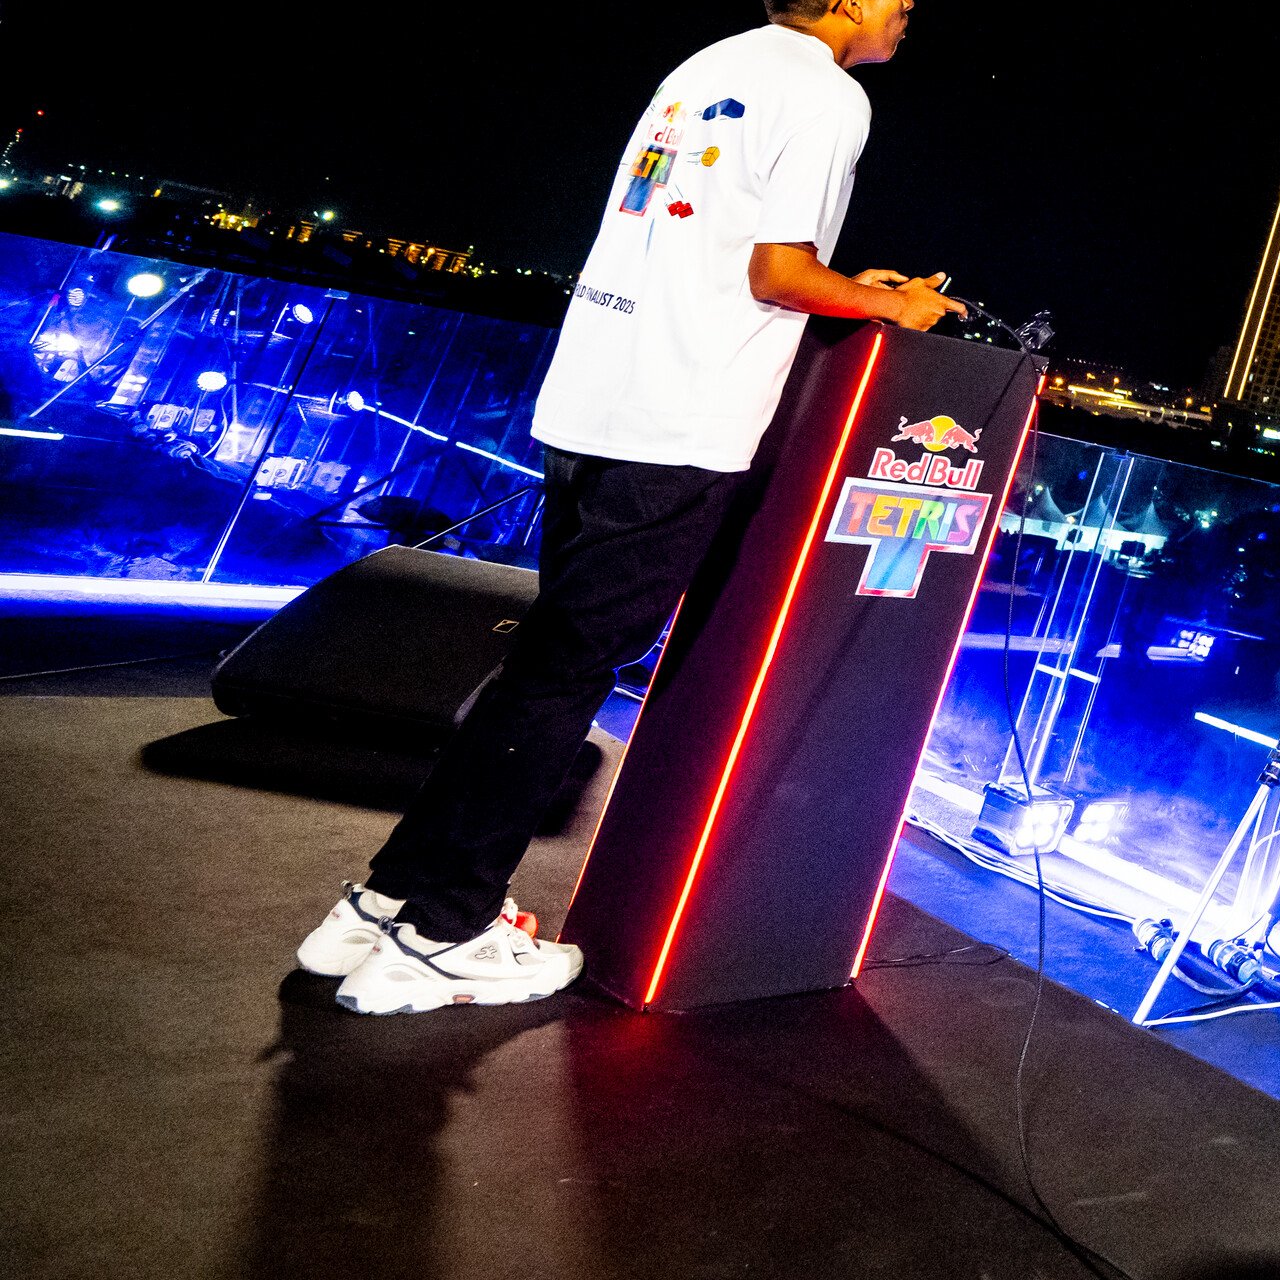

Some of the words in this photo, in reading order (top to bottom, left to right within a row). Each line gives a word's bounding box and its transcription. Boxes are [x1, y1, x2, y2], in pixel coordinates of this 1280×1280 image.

[612, 296, 636, 314] 2025
[868, 448, 929, 483] Red
[925, 453, 984, 490] Bull
[846, 491, 981, 543] TETRIS
